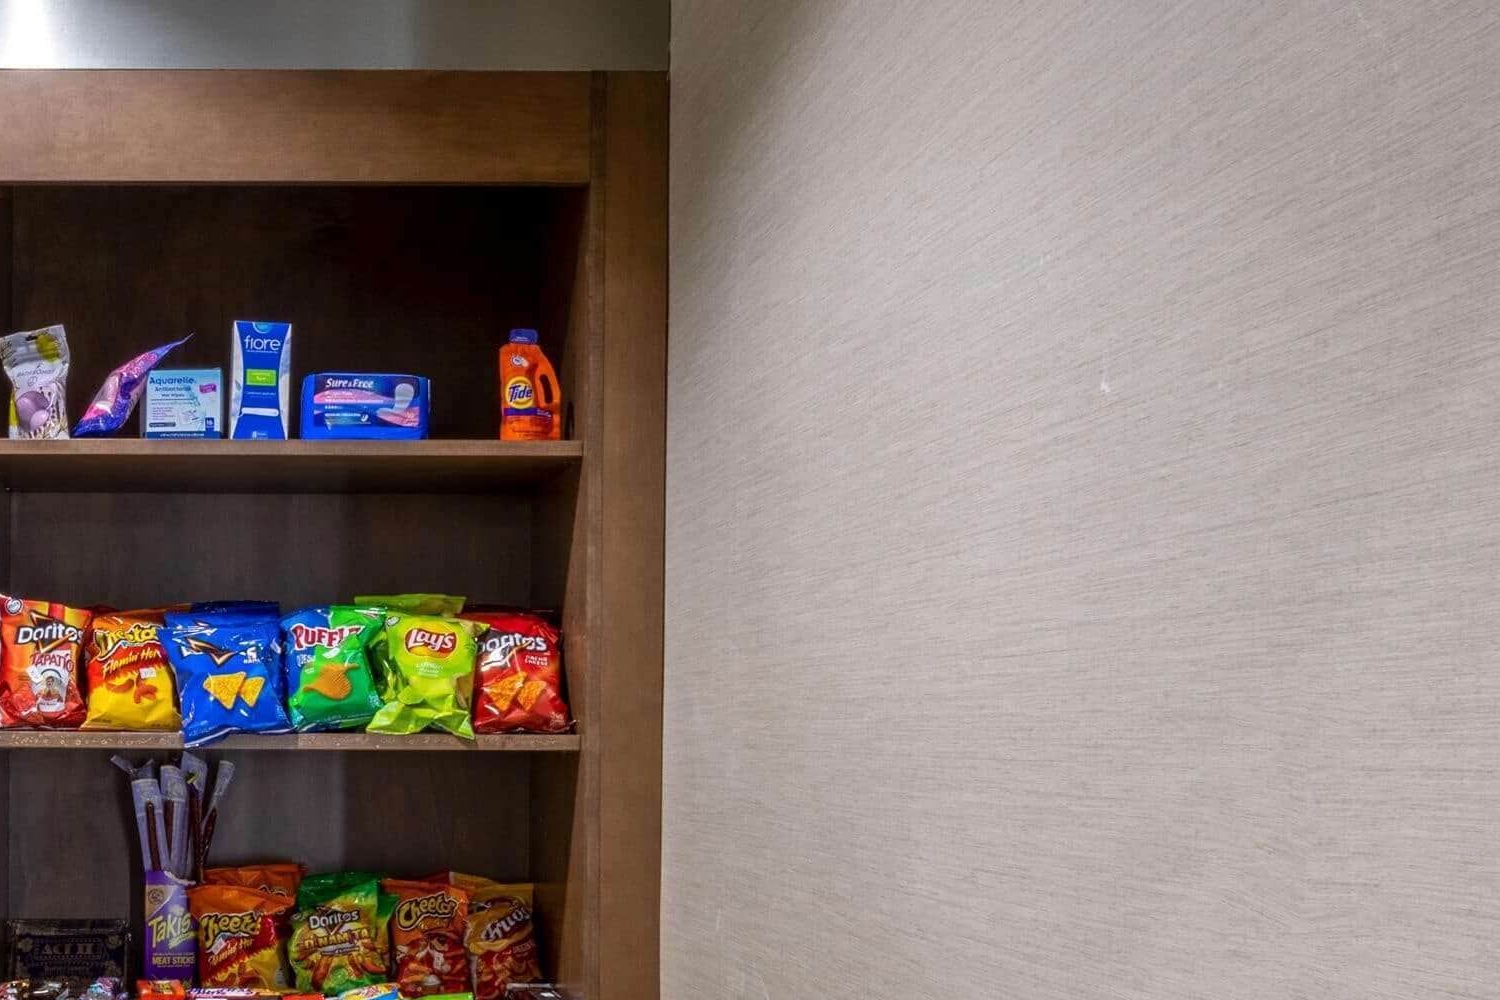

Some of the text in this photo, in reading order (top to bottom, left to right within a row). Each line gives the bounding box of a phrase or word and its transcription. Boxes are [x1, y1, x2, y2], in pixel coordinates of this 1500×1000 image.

[243, 334, 281, 351] fiore
[325, 378, 349, 388] Sure
[508, 384, 533, 402] Tide
[408, 628, 455, 651] Lay's
[309, 910, 359, 929] Doritos
[148, 913, 192, 948] Takis
[152, 956, 171, 966] MEAT
